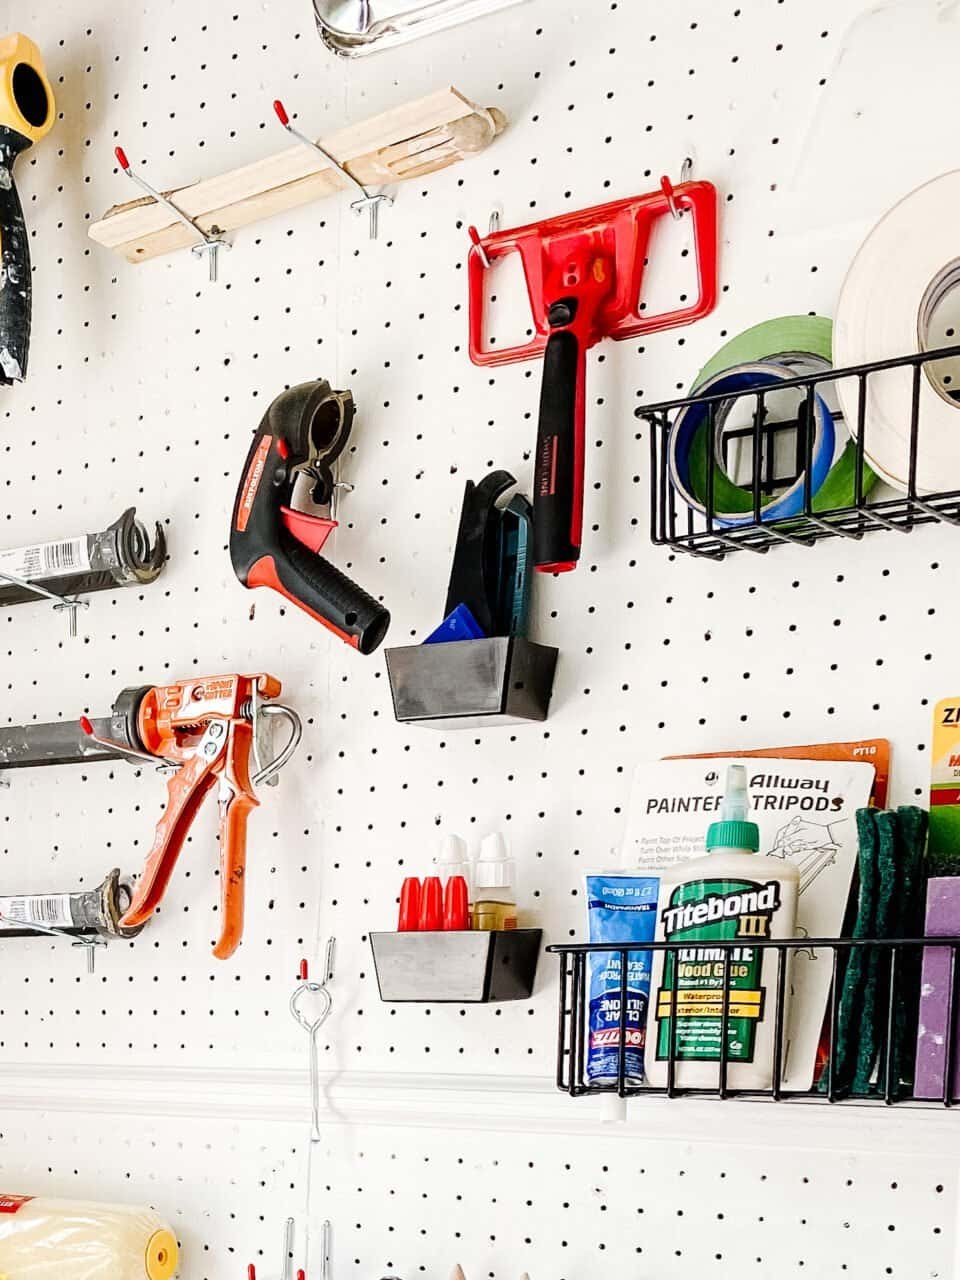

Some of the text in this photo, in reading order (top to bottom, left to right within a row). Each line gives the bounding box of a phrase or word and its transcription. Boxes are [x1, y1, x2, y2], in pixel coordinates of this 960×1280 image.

[748, 774, 830, 794] Allway
[752, 794, 845, 812] TRIPODS
[663, 884, 776, 933] Titebond
[737, 914, 768, 936] III
[606, 960, 644, 969] SEAANT
[598, 970, 650, 981] WATEPROOF
[600, 999, 644, 1010] SILIONE
